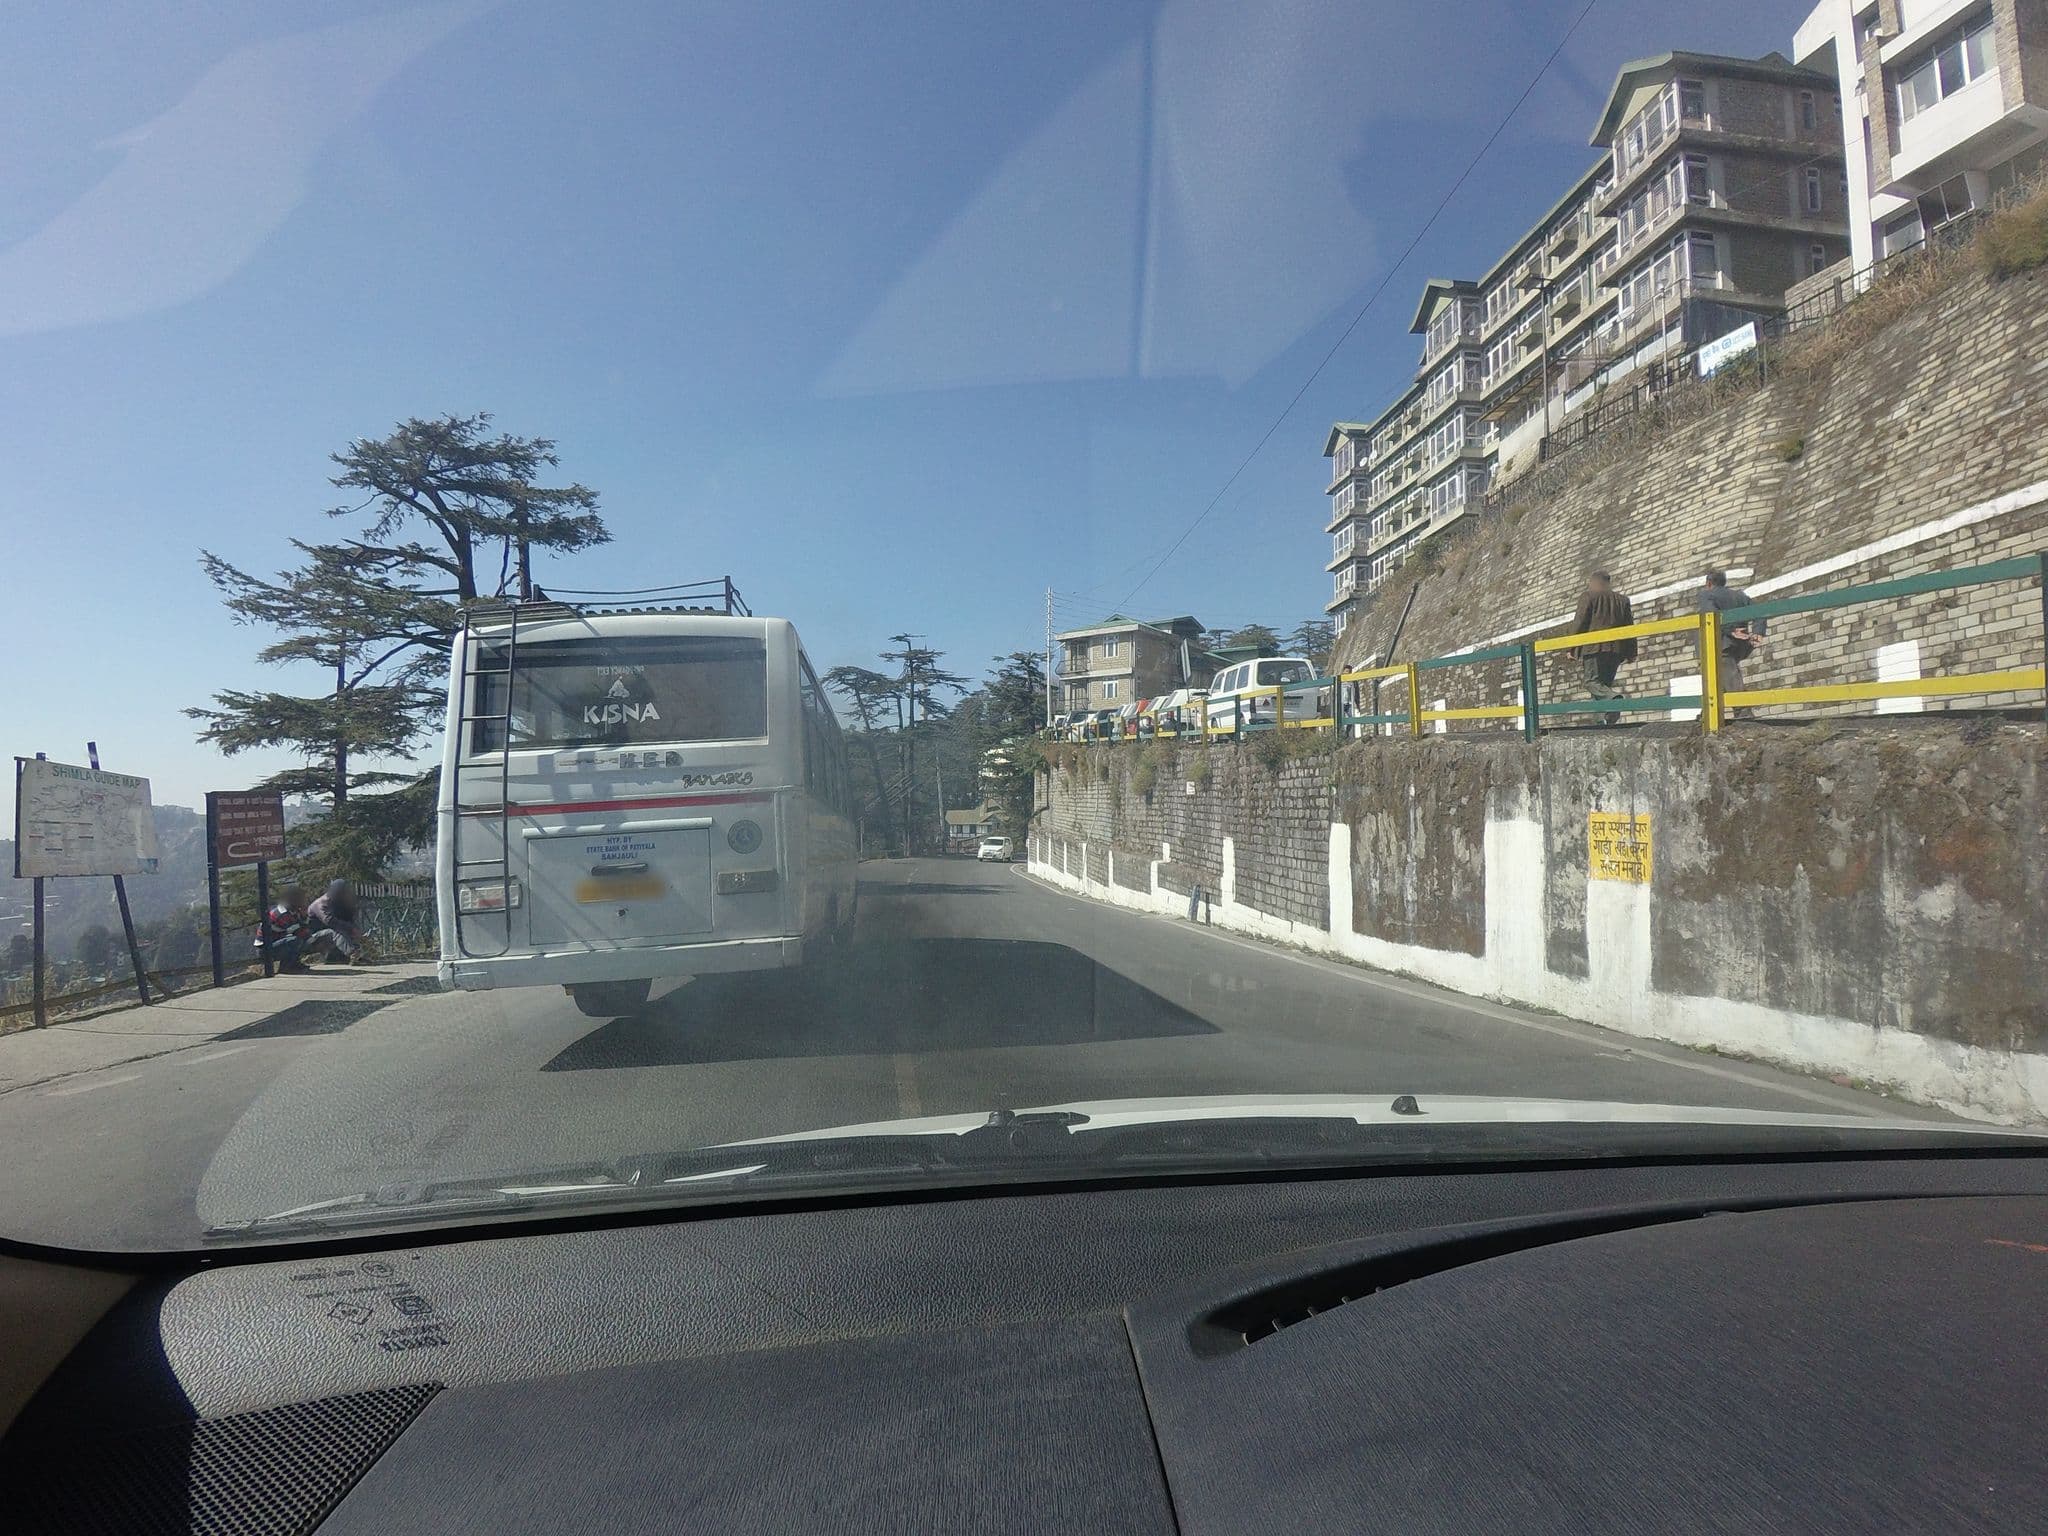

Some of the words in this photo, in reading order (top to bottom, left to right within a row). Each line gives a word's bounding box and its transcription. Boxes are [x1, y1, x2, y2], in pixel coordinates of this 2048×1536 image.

[584, 702, 660, 725] KISNA
[52, 766, 93, 781] SHIMLA
[94, 771, 121, 786] GUIDE
[122, 777, 141, 789] MAP
